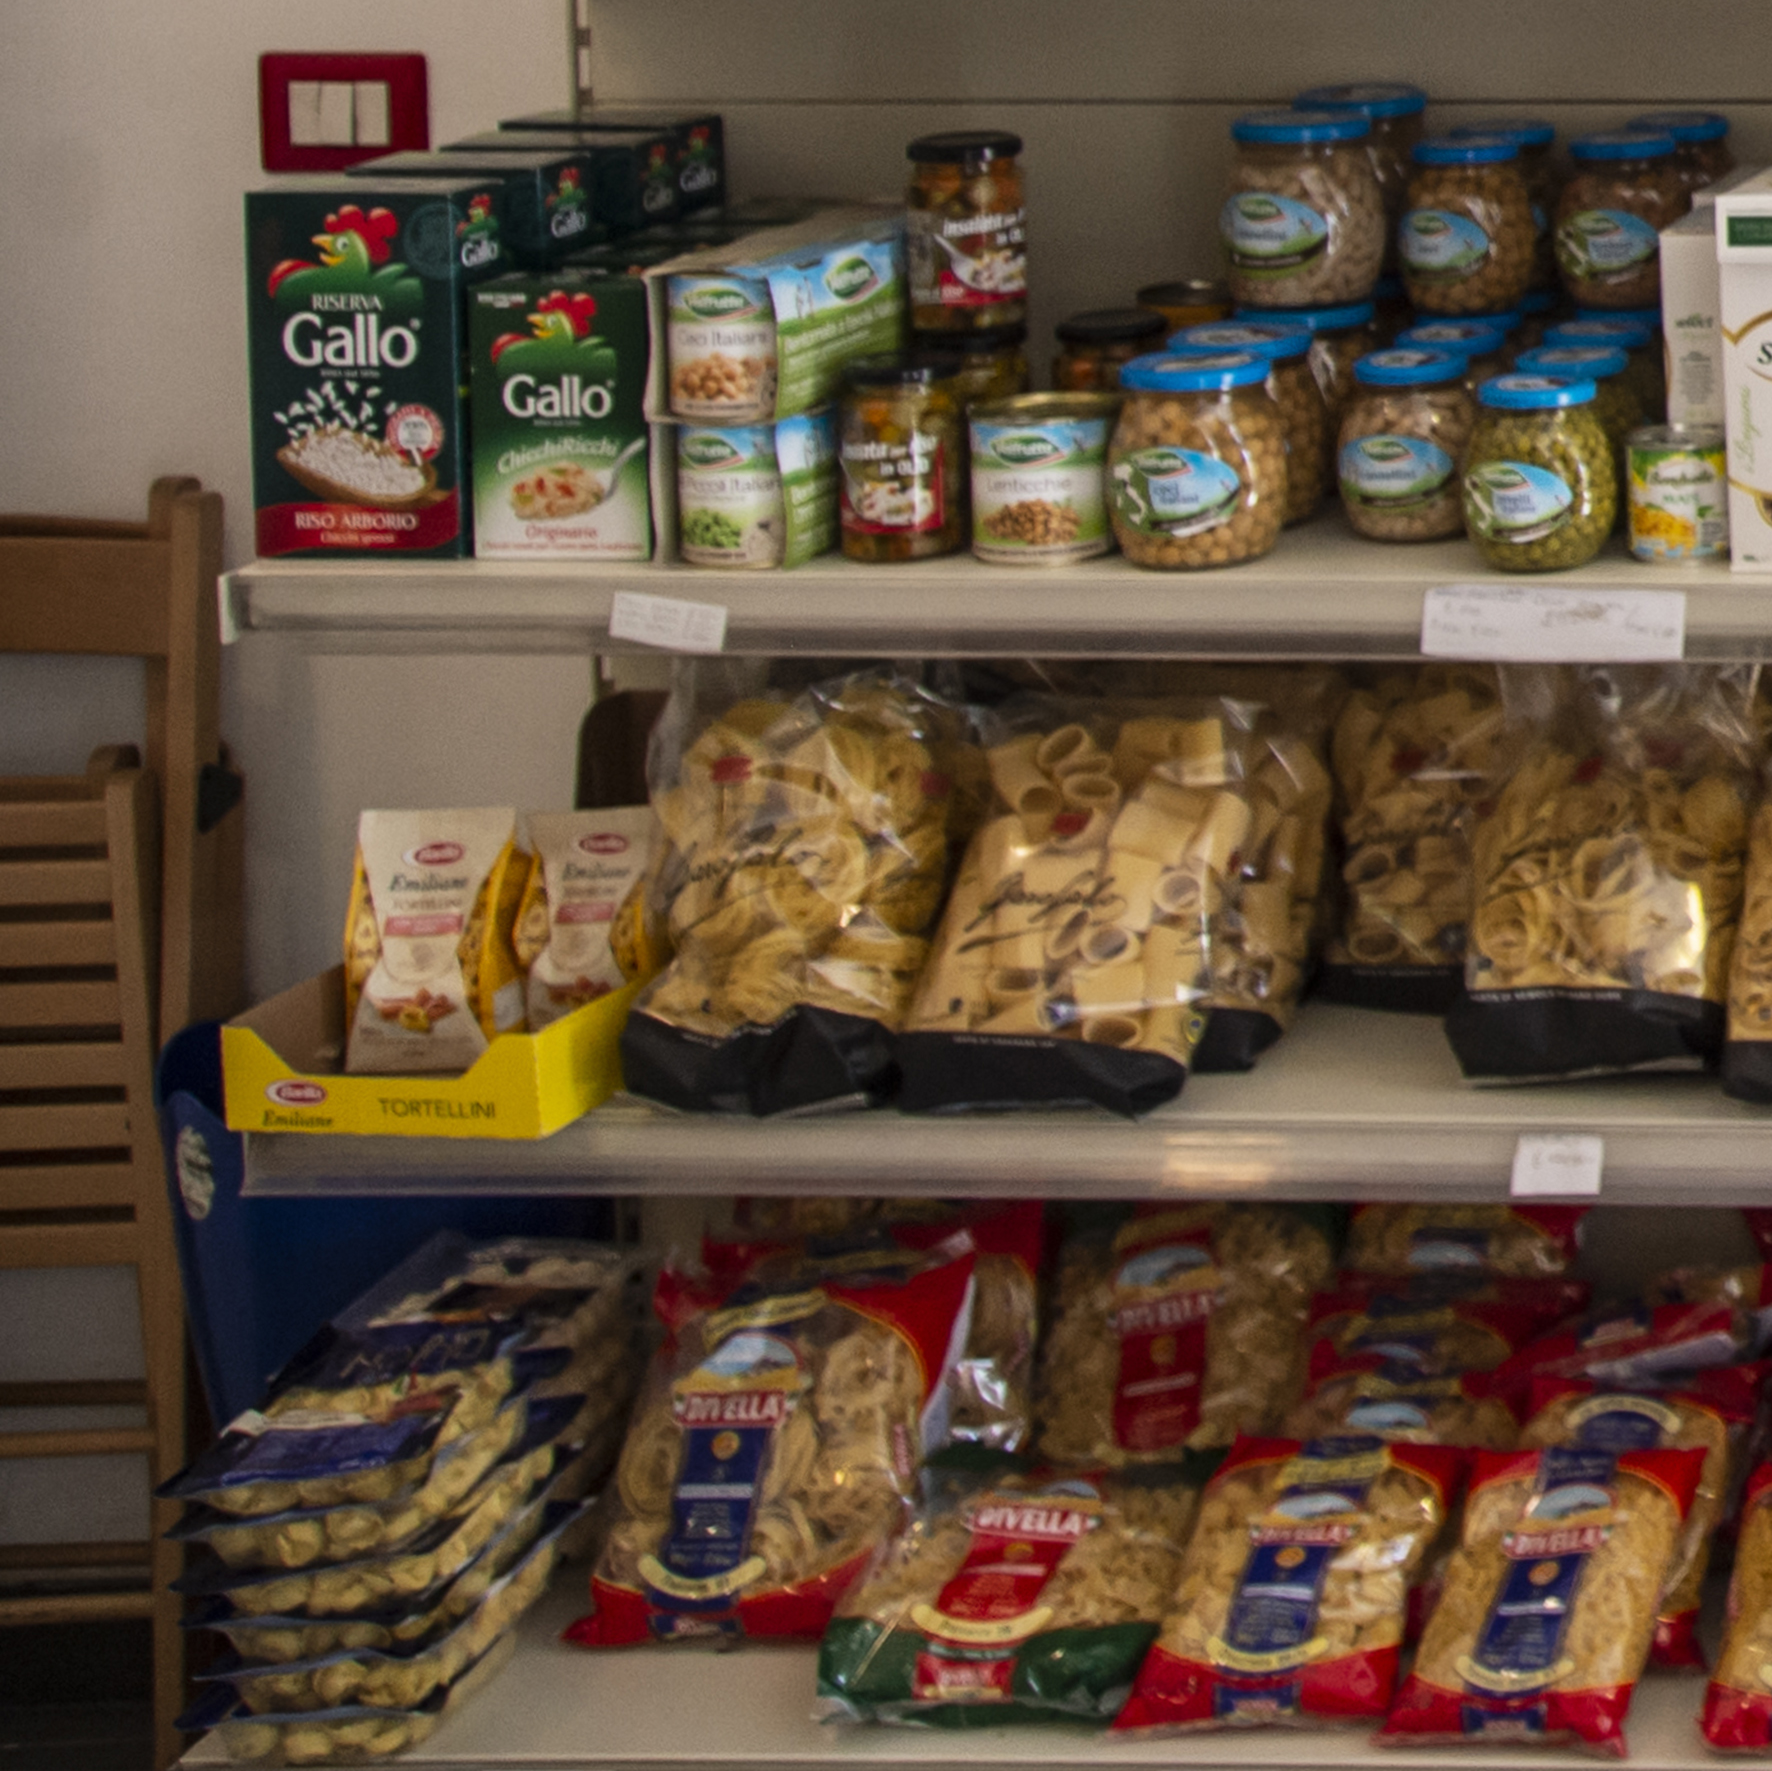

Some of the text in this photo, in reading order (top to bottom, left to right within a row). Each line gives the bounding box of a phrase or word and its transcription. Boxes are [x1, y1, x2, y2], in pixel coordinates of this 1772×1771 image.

[311, 293, 384, 312] RISERVA
[282, 311, 418, 368] Gallo
[502, 373, 613, 418] Gallo
[988, 477, 1072, 495] Lenticchie
[294, 511, 418, 530] RISO ARBORIO
[377, 1098, 497, 1119] TORTELLINI
[686, 1394, 785, 1423] DIVELLA
[978, 1507, 1082, 1534] DIVELLA
